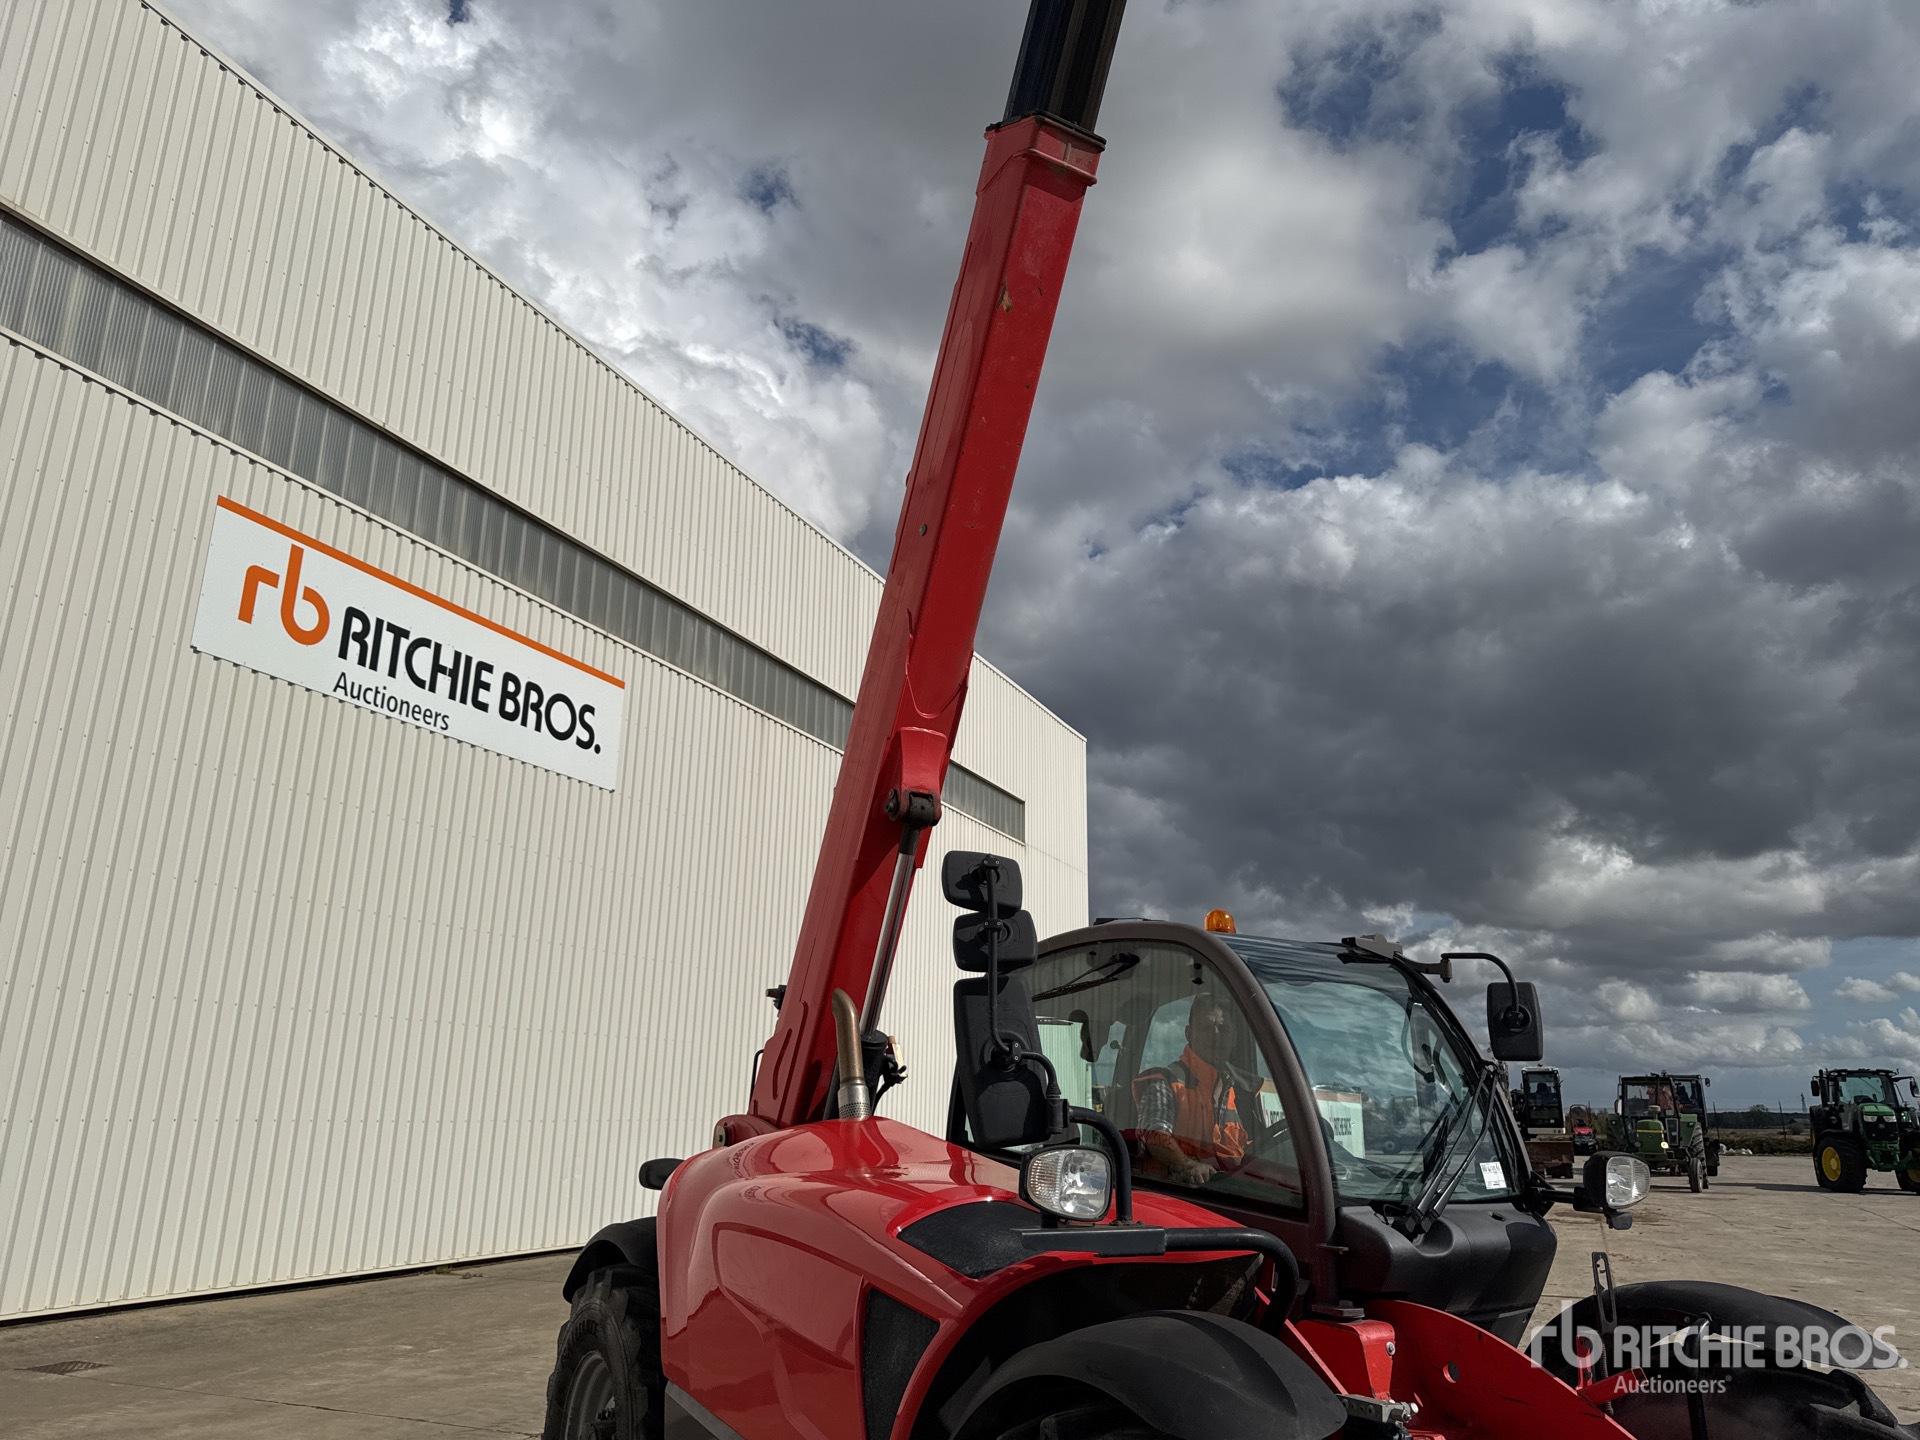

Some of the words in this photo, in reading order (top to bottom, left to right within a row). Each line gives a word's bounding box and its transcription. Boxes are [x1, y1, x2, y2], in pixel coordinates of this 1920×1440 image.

[238, 544, 330, 646] rb
[333, 671, 450, 731] Auctioneers
[338, 606, 494, 713] RITCHIE
[498, 671, 602, 755] BROS.
